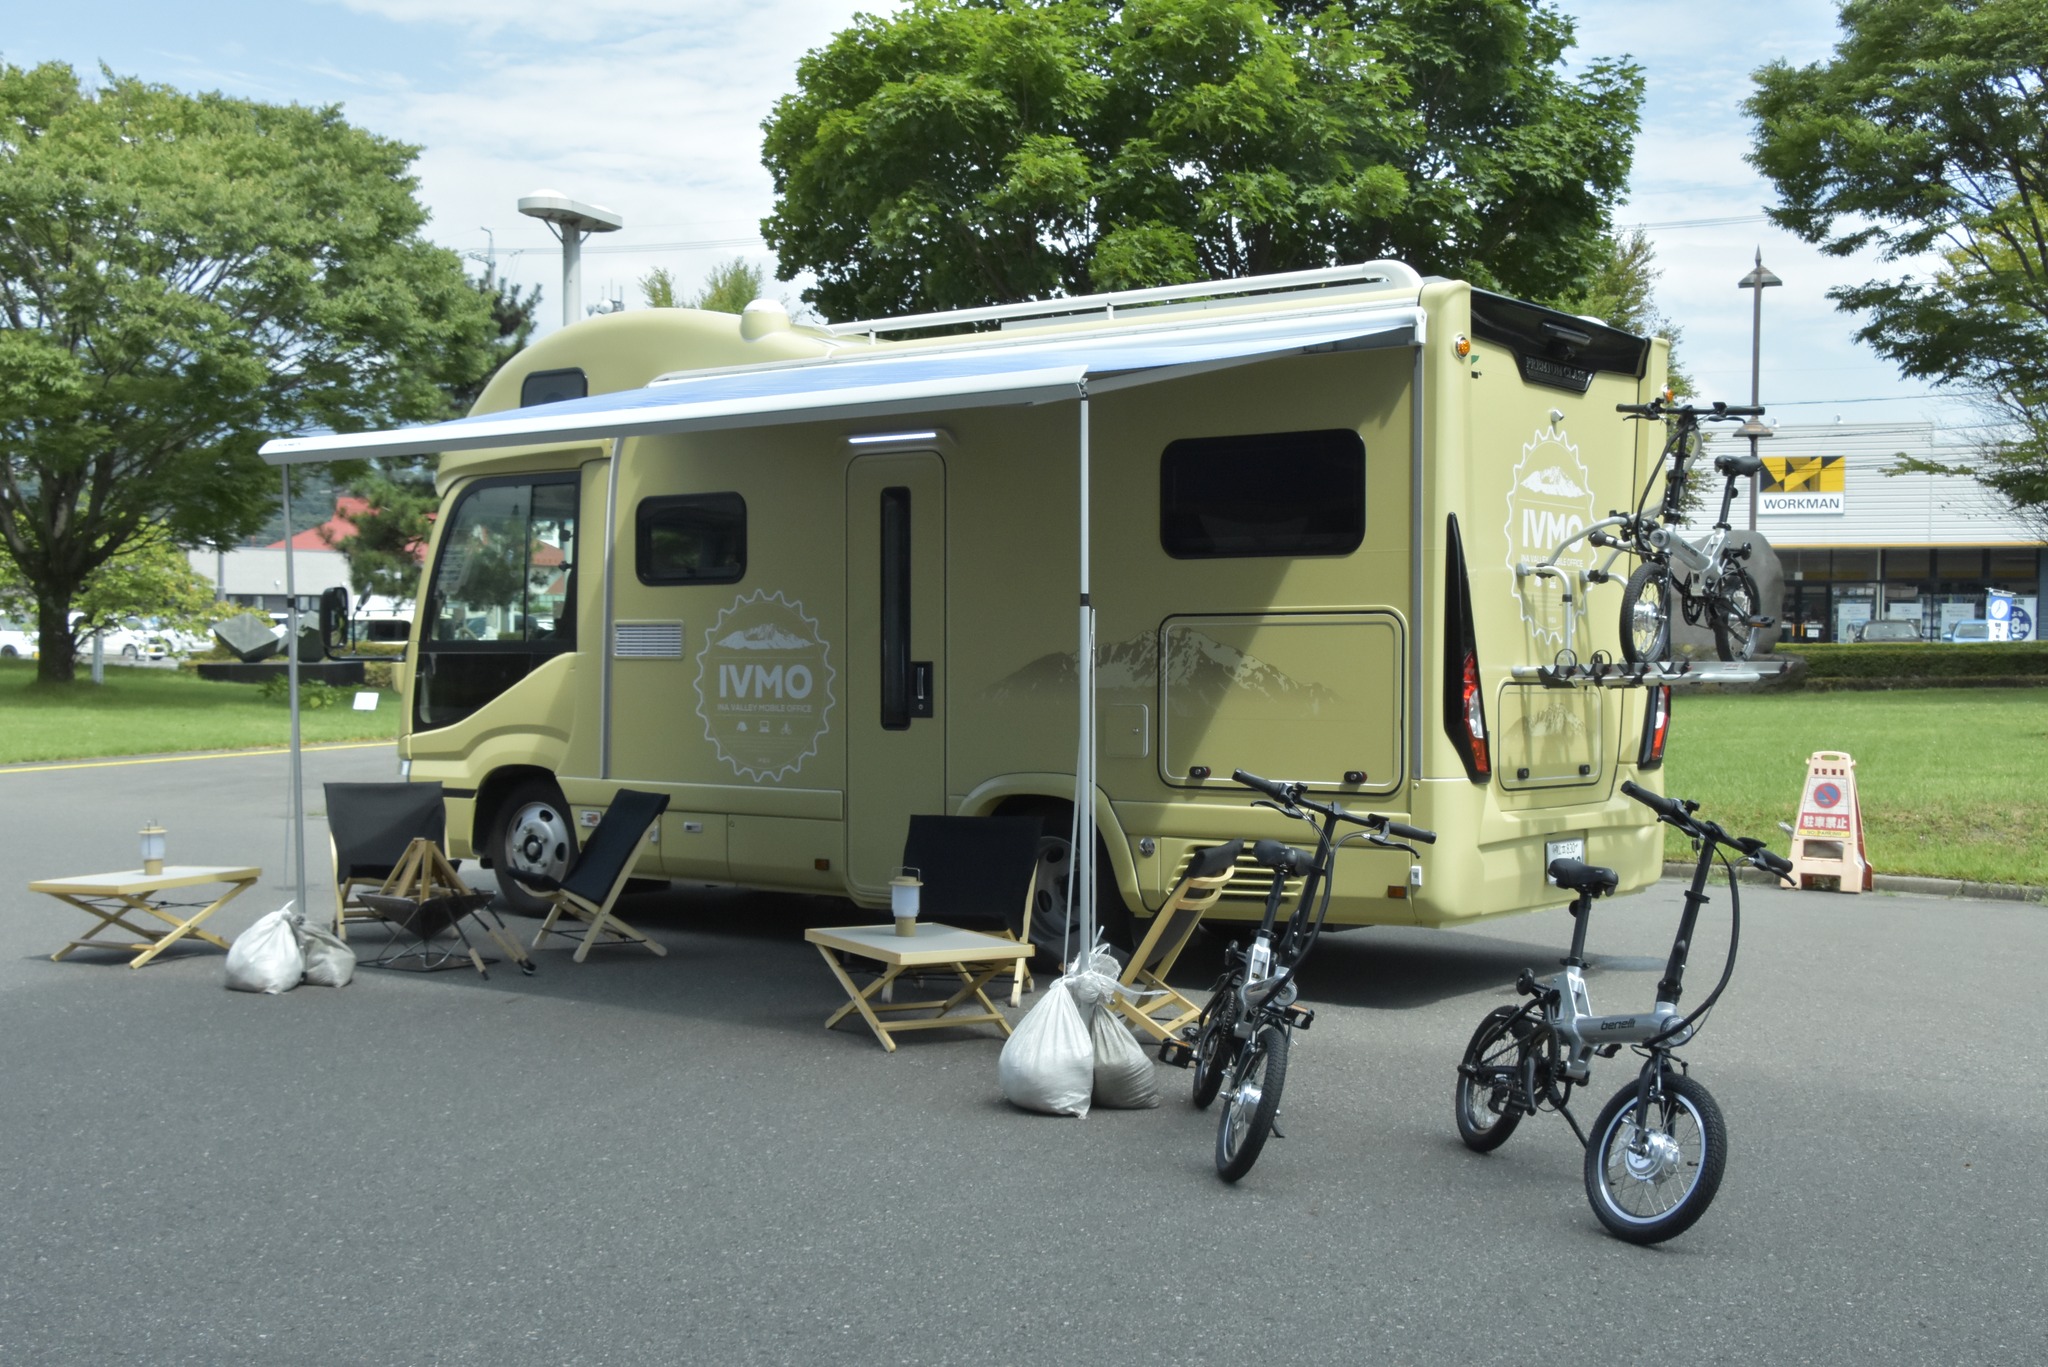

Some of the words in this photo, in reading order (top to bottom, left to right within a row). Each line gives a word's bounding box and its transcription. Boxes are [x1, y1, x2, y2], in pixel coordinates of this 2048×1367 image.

[1525, 356, 1563, 377] PREMIUM
[1764, 499, 1840, 509] WORKMAN
[1523, 508, 1583, 553] IVMO
[719, 664, 813, 699] IVMO
[717, 703, 729, 711] INA
[730, 704, 758, 712] VALLEY
[758, 704, 785, 712] MOBILE
[786, 705, 812, 713] OFFICE
[1600, 1017, 1636, 1030] benelli
